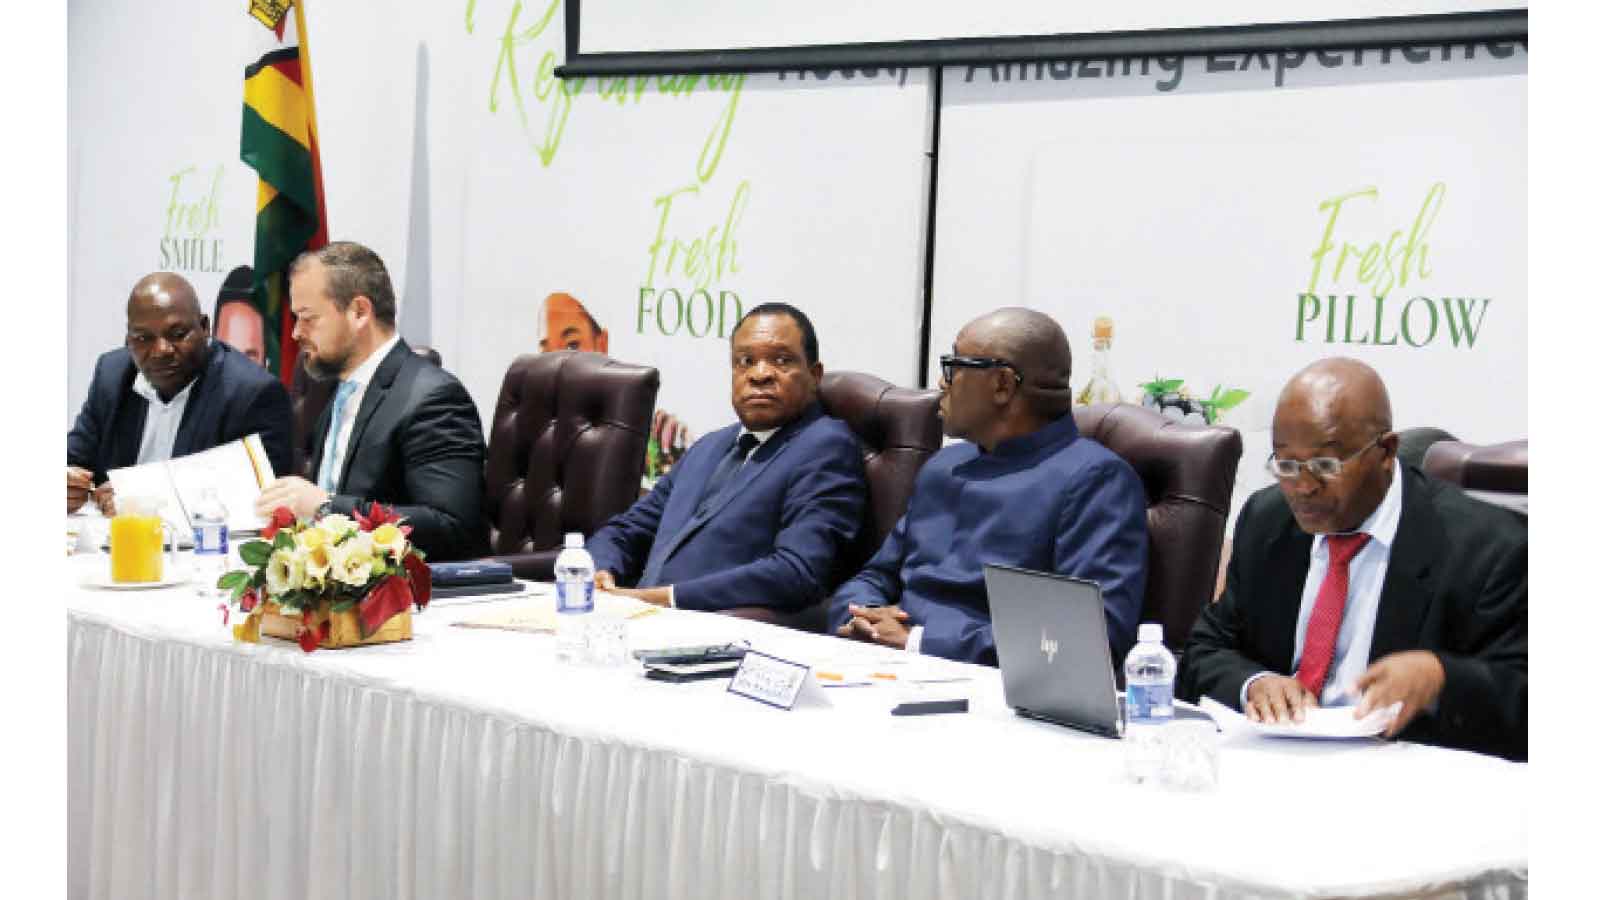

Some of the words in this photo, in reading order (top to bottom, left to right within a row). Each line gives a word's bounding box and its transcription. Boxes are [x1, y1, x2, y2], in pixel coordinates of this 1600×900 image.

[163, 163, 225, 240] Fresh
[648, 180, 750, 289] Fresh
[160, 239, 224, 273] SMILE
[1308, 181, 1446, 299] Fresh
[636, 287, 743, 338] FOOD
[1294, 293, 1492, 350] PILLOW
